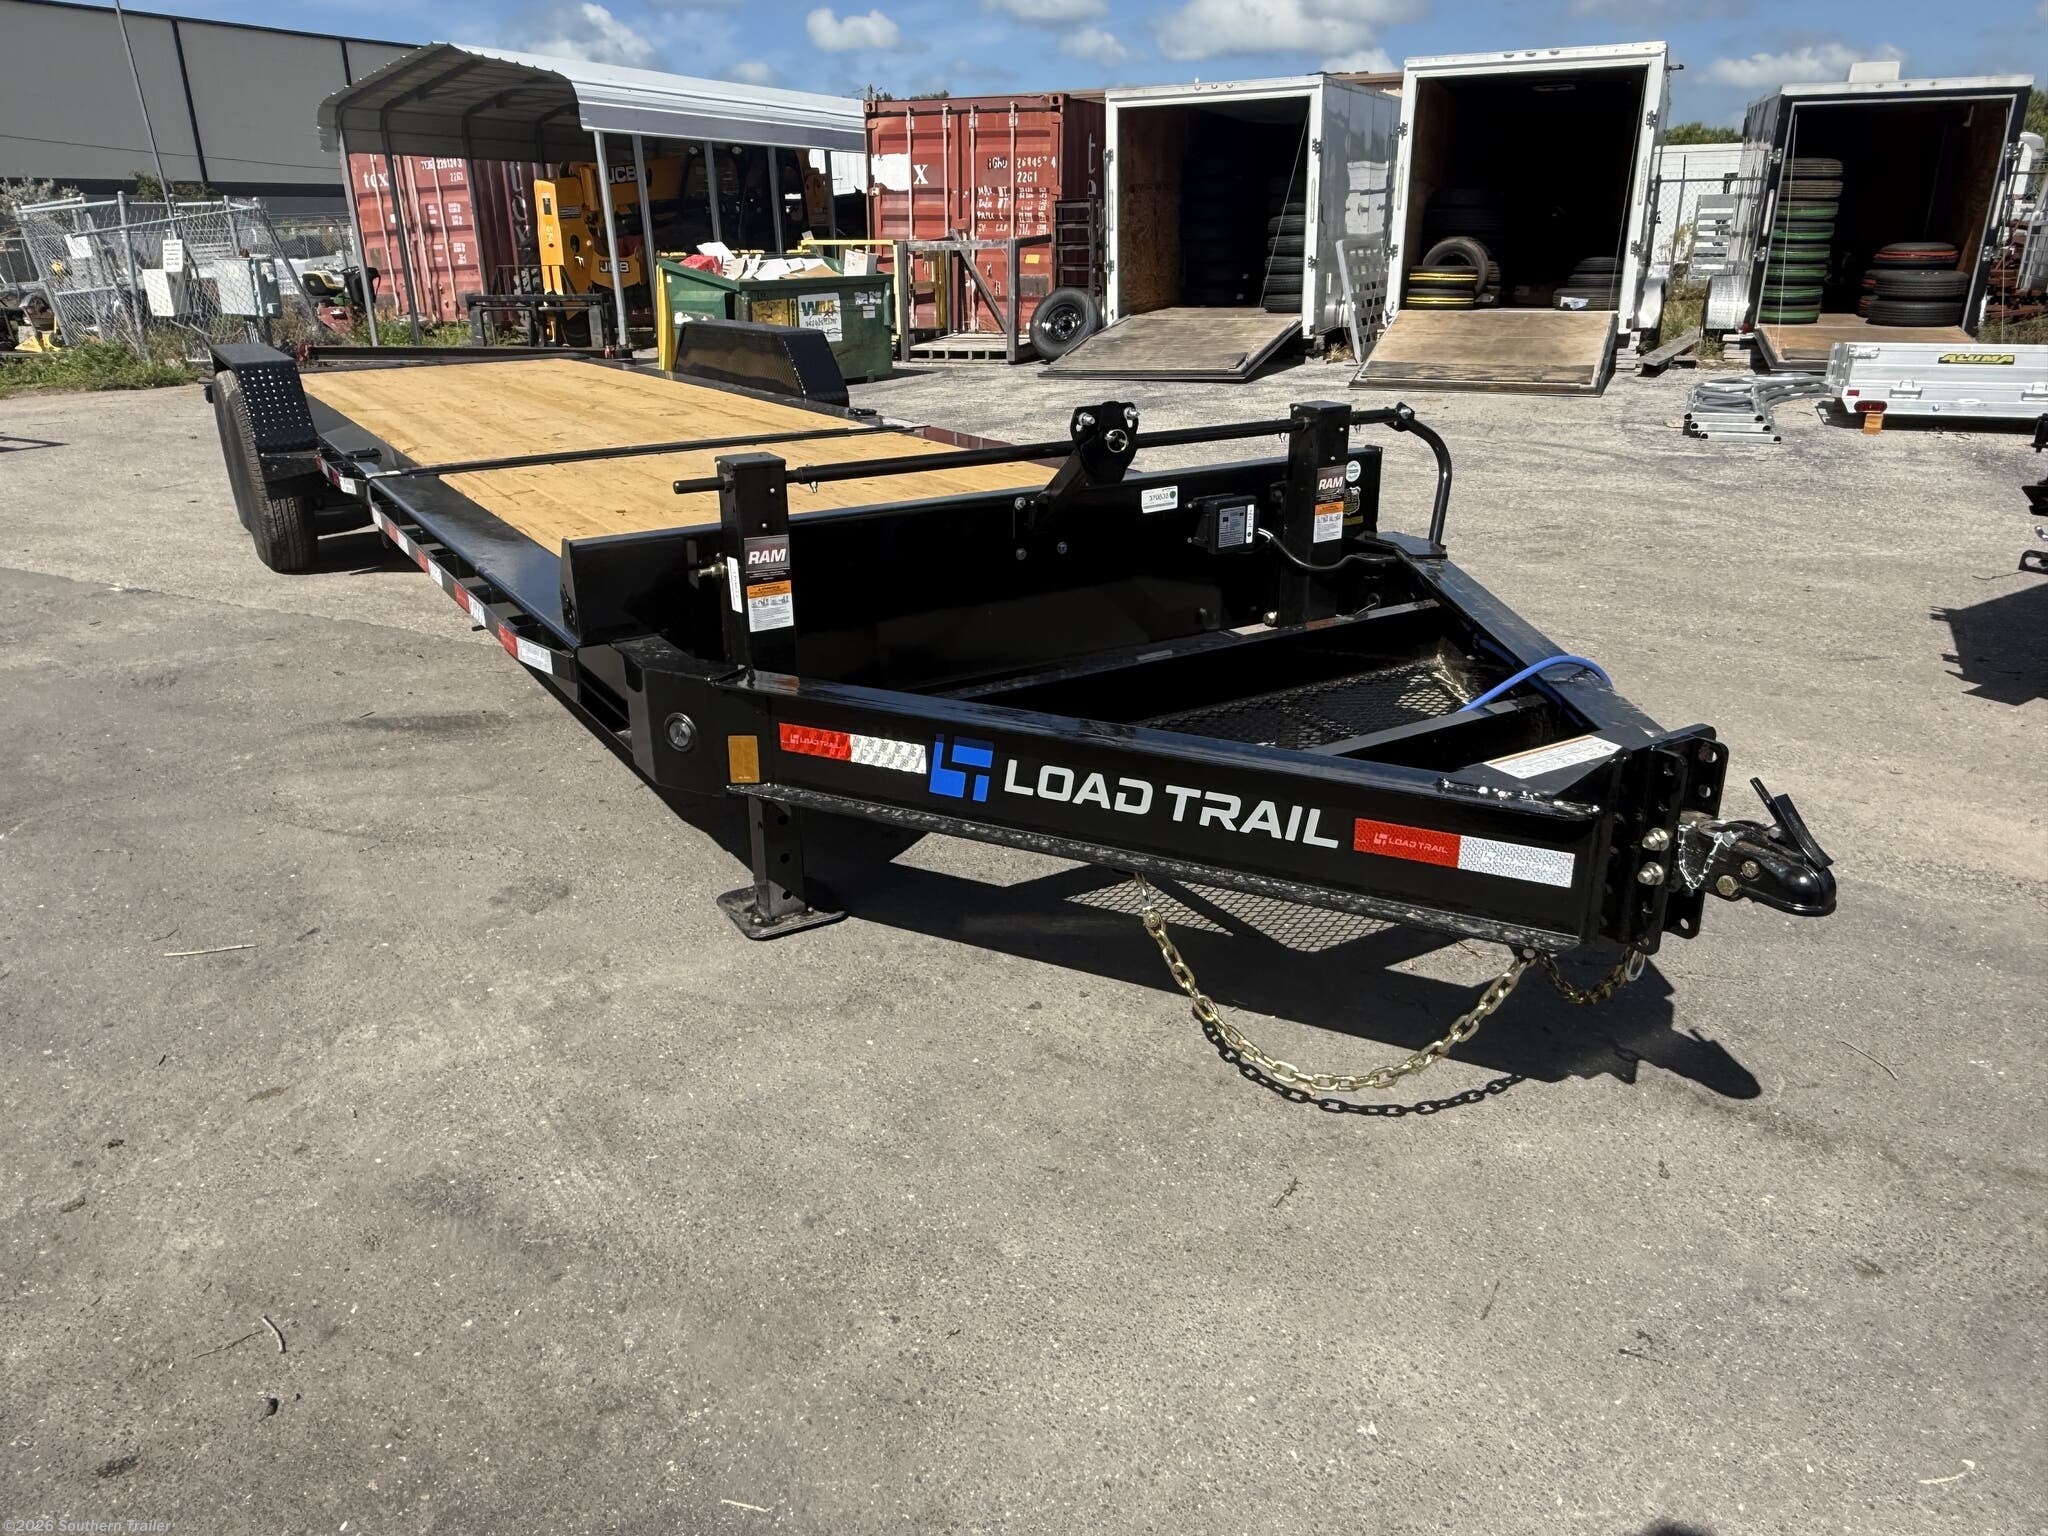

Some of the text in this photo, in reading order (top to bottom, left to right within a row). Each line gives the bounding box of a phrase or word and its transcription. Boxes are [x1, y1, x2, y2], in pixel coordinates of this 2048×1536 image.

[606, 166, 637, 183] JCB
[600, 261, 629, 272] JB
[1939, 353, 2015, 365] ALUMA
[1318, 476, 1344, 491] RAM
[748, 547, 787, 565] RAM
[1004, 758, 1339, 849] LOAD TRAIL
[1388, 838, 1449, 854] LOAD TRAIL
